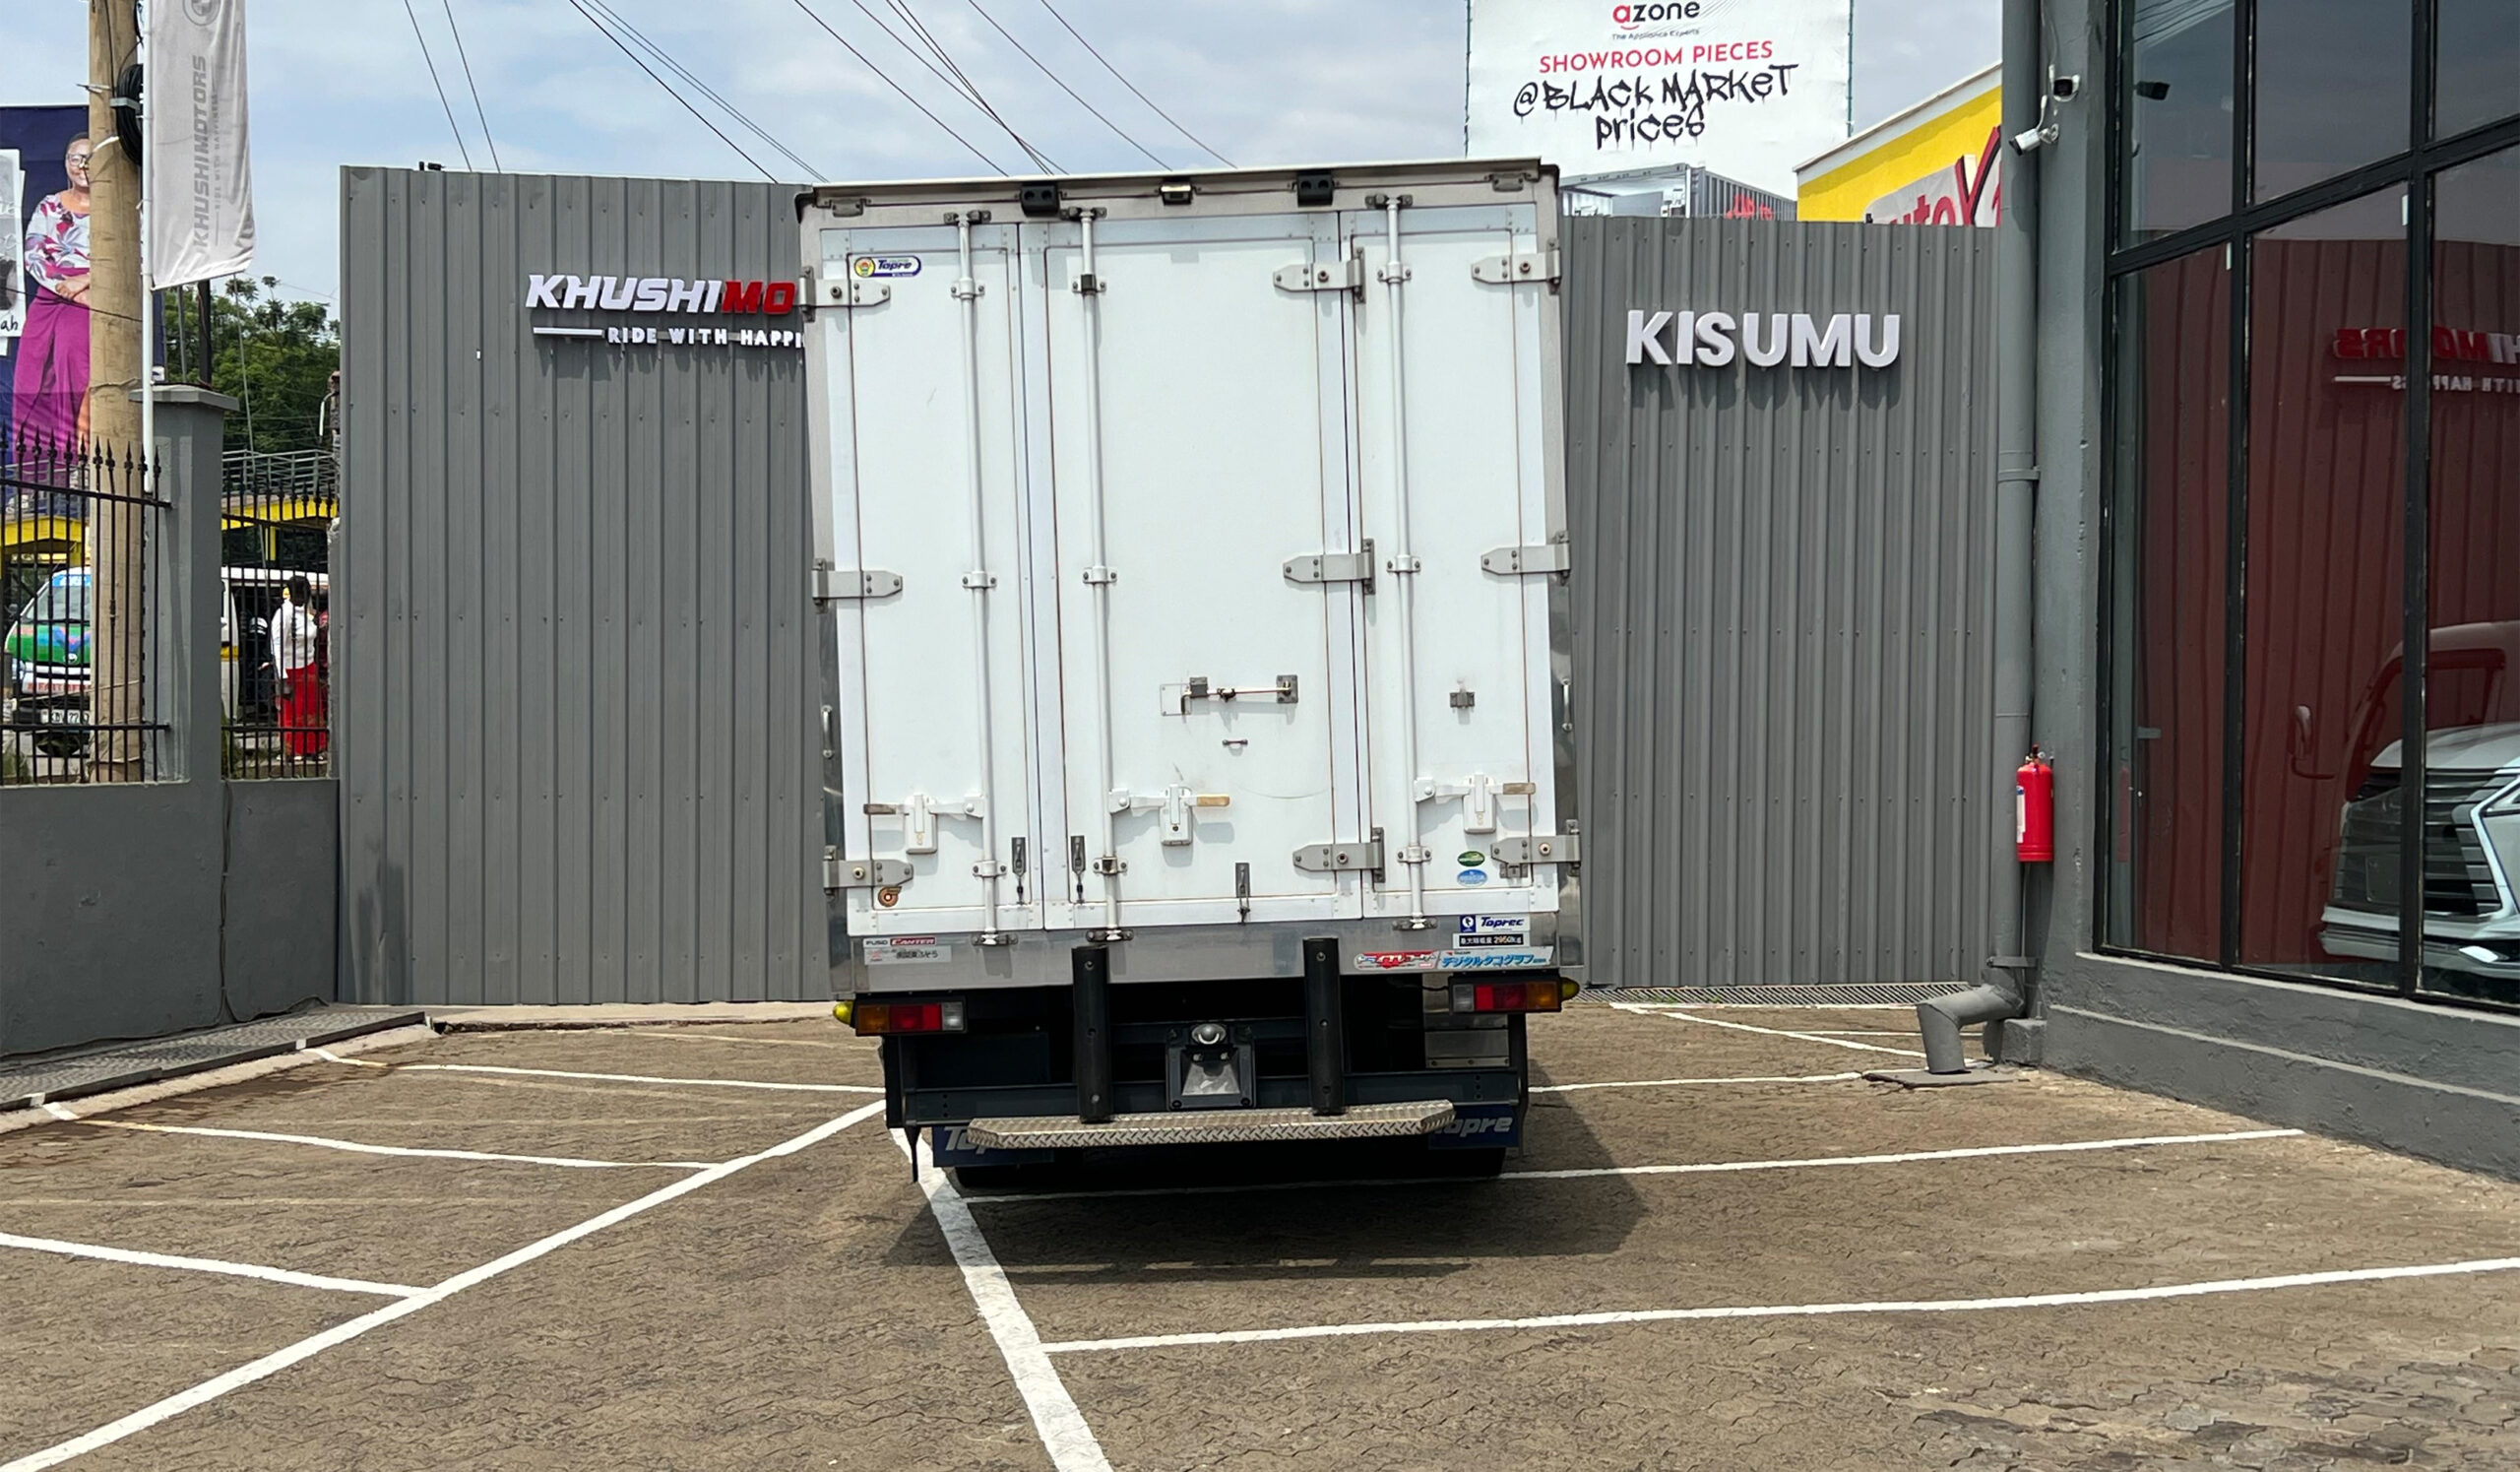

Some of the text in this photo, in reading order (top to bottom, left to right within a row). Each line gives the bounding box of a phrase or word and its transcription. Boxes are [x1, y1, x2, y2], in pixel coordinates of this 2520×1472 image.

[1612, 1, 1700, 24] azone
[1539, 40, 1774, 74] SHOWROOM PIECES
[1596, 102, 1705, 150] prices
[878, 259, 913, 271] Topre
[525, 274, 797, 315] KHUSHIMO
[607, 327, 802, 349] RIDE WITH HAPPI
[1625, 309, 1901, 368] KISUMU
[1480, 916, 1525, 928] Toprec
[1434, 1117, 1513, 1138] opre
